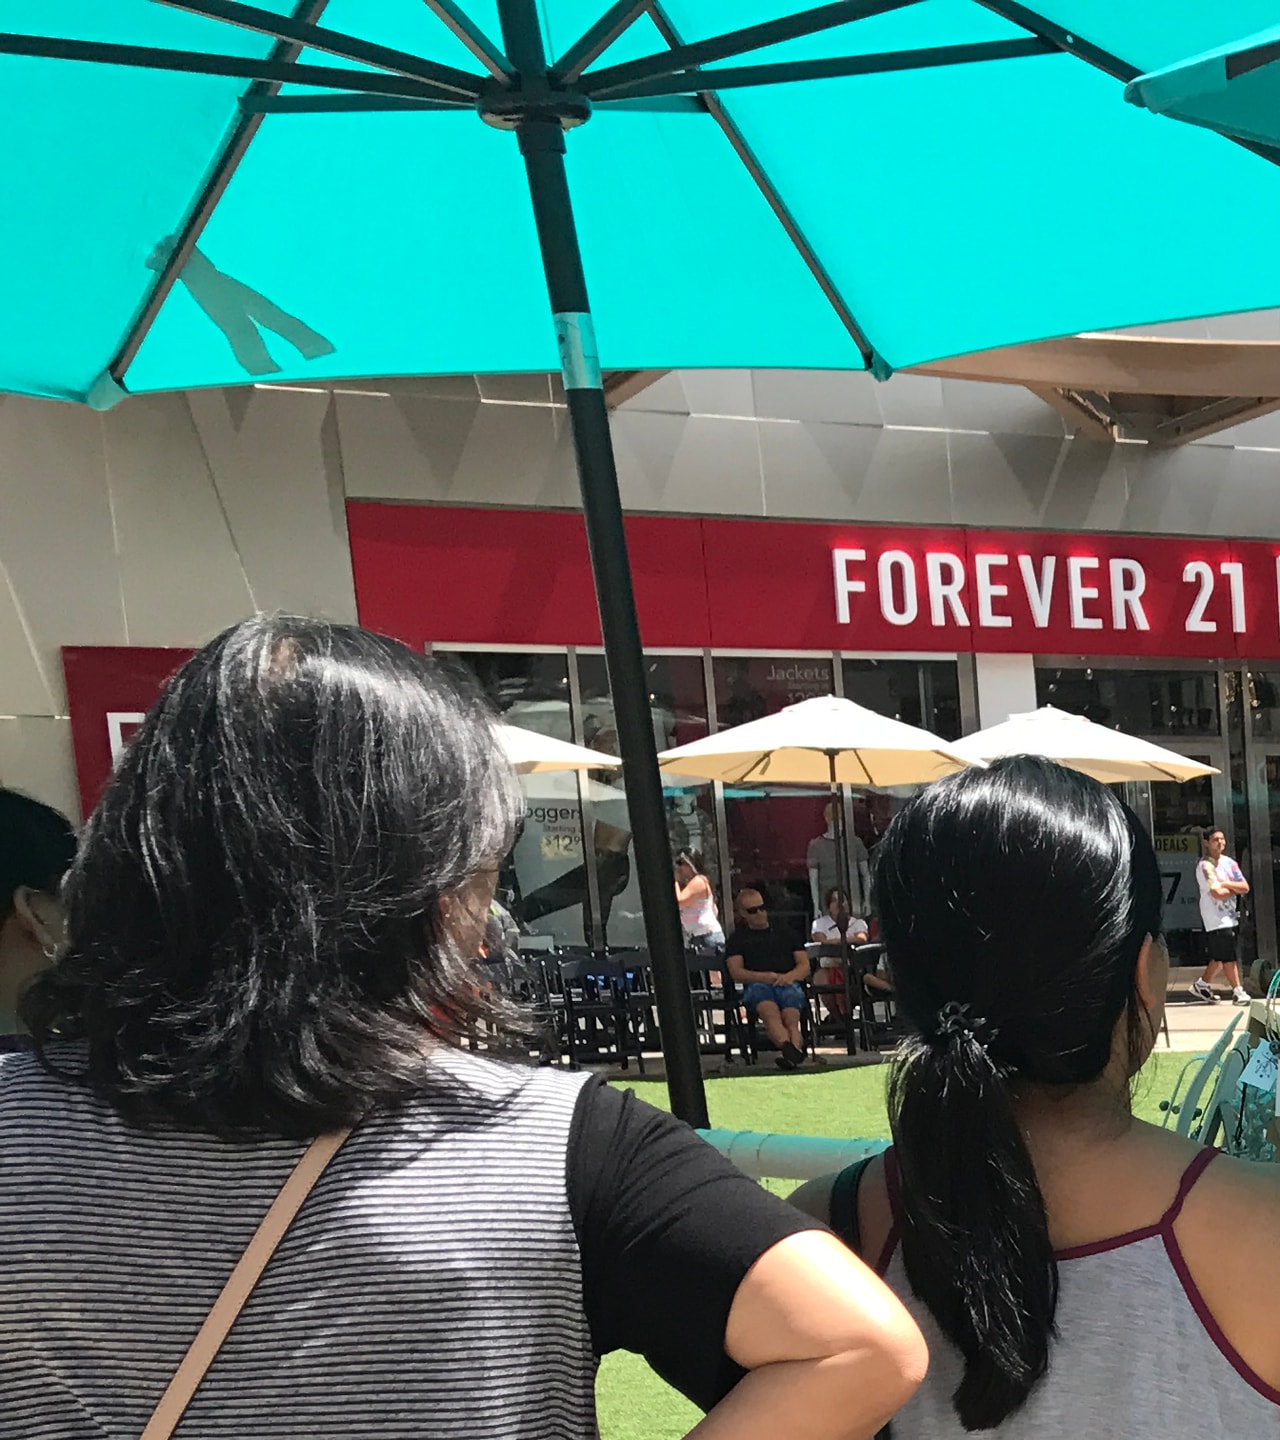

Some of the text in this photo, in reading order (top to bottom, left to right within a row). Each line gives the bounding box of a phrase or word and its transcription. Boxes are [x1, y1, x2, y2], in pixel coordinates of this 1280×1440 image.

[832, 546, 1247, 634] FOREVER 21
[766, 663, 830, 681] Jackets
